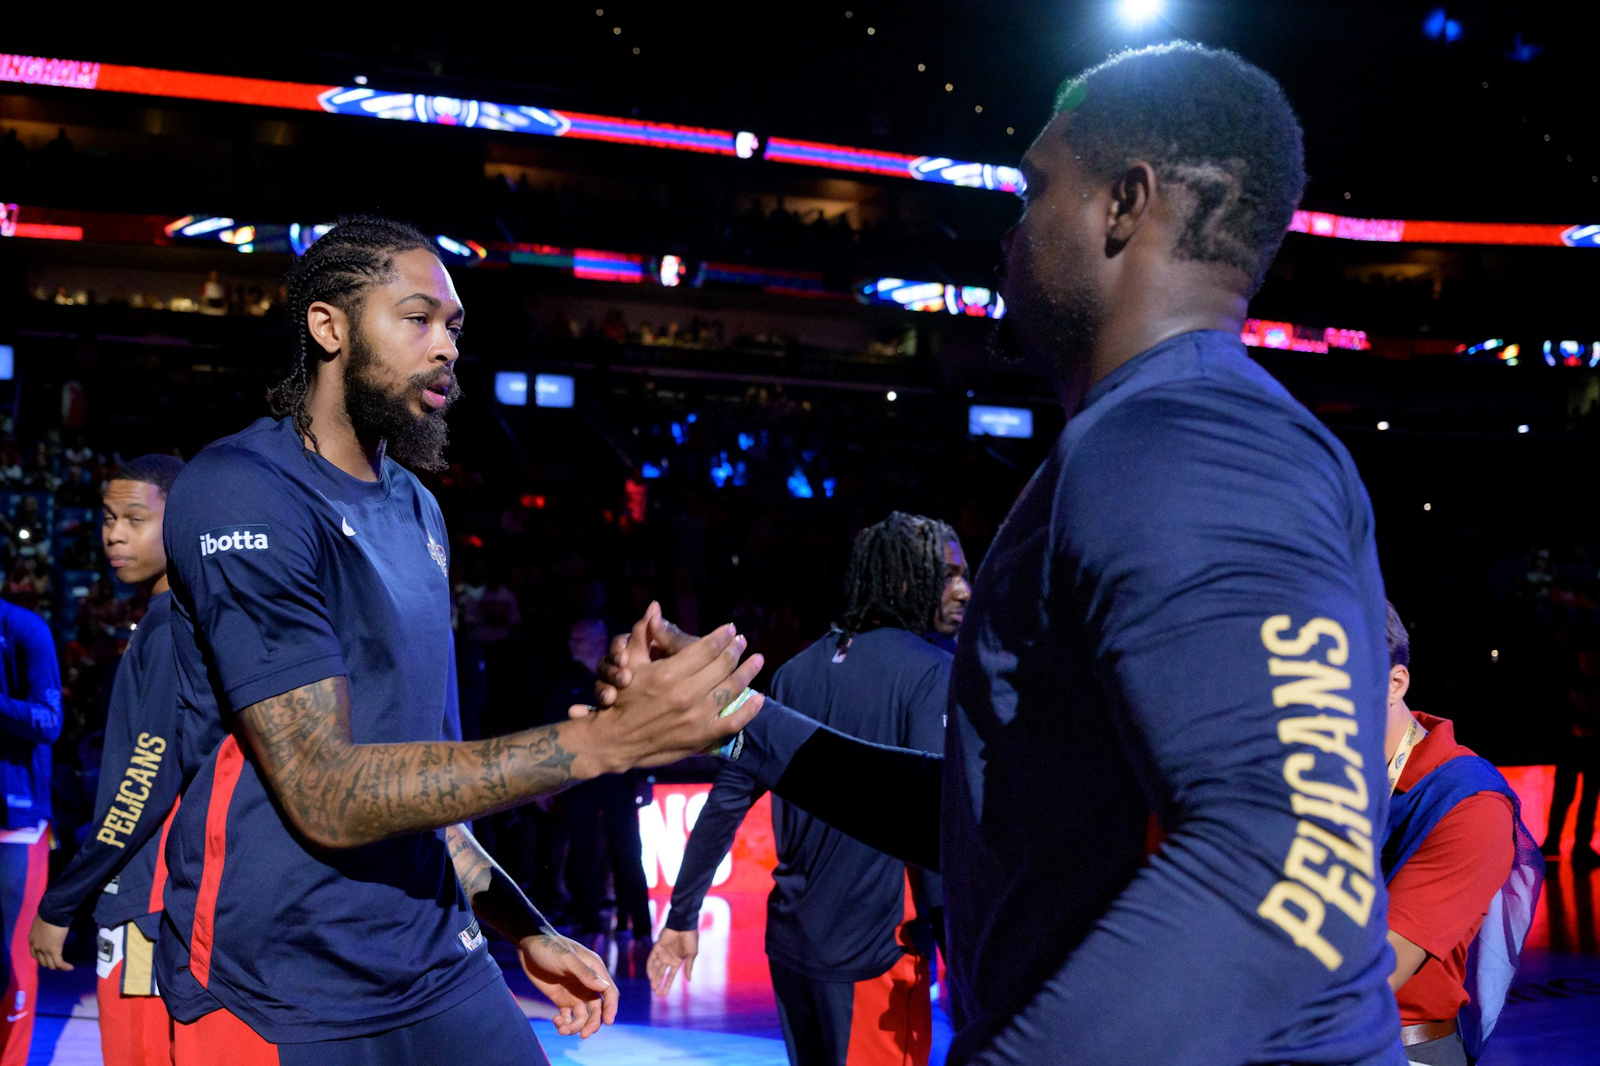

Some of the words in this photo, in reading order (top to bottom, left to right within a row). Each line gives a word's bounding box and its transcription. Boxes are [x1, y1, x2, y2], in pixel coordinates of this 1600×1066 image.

[199, 530, 269, 557] ibotta
[96, 732, 167, 849] PELICANS
[1257, 614, 1376, 972] PELICANS
